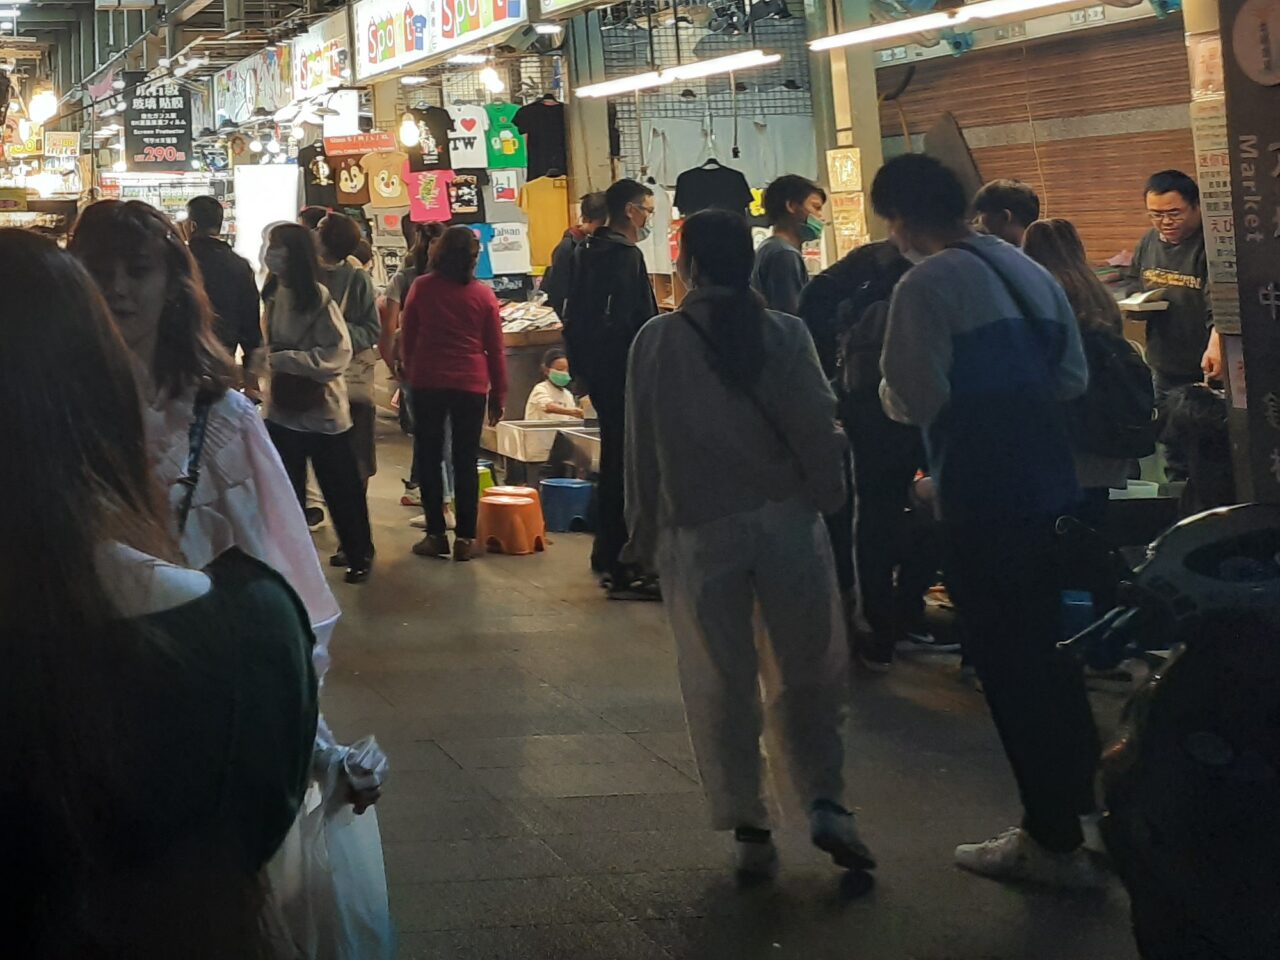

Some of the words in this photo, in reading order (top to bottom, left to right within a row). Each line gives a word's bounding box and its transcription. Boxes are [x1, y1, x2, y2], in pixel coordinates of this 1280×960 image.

[369, 8, 414, 61] Sport
[143, 146, 178, 162] 290
[450, 136, 478, 151] TW
[1238, 134, 1265, 243] Market
